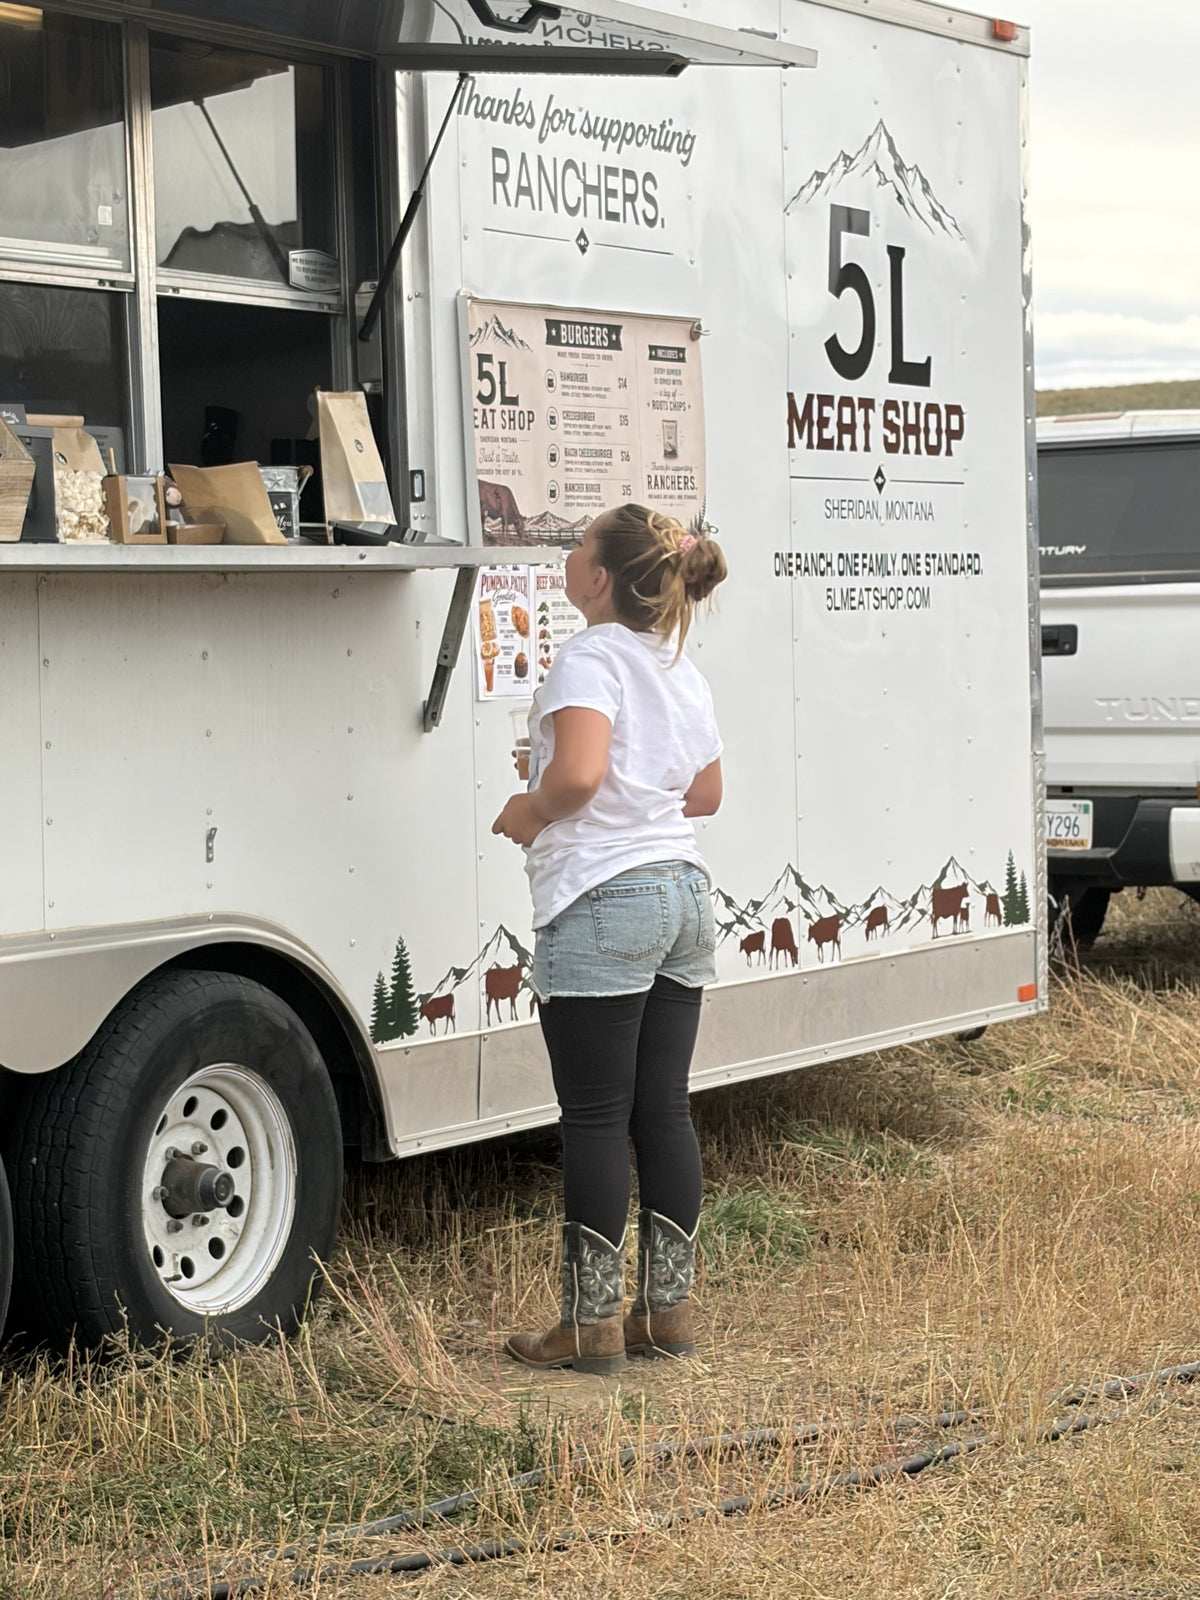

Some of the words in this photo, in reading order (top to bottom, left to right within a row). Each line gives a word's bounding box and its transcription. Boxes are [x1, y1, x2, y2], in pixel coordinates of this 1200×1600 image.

[457, 76, 535, 129] Thanks
[538, 94, 577, 144] for
[580, 110, 696, 167] supporting
[492, 147, 665, 229] RANCHERS.
[824, 203, 932, 387] 5L
[560, 324, 609, 347] BURGERS
[476, 353, 519, 406] 5L
[617, 377, 628, 390] $14
[473, 408, 497, 429] EAT
[500, 409, 535, 431] SHOP
[619, 414, 629, 426] $15
[787, 392, 876, 452] MEAT
[882, 399, 965, 457] SHOP
[620, 450, 631, 462] $16
[621, 484, 632, 497] $15
[647, 474, 698, 491] RANCHERS.
[824, 499, 882, 521] SHERIDAN,
[886, 501, 935, 521] MONTANA
[1038, 545, 1086, 556] NTURY
[774, 552, 794, 577] ONE
[795, 552, 836, 577] RANCH.
[837, 553, 860, 577] ONE
[901, 553, 922, 577] ONE
[924, 553, 984, 577] STANDARD.
[826, 586, 931, 611] 5LMEATSHOP.COM
[1047, 815, 1080, 837] Y296
